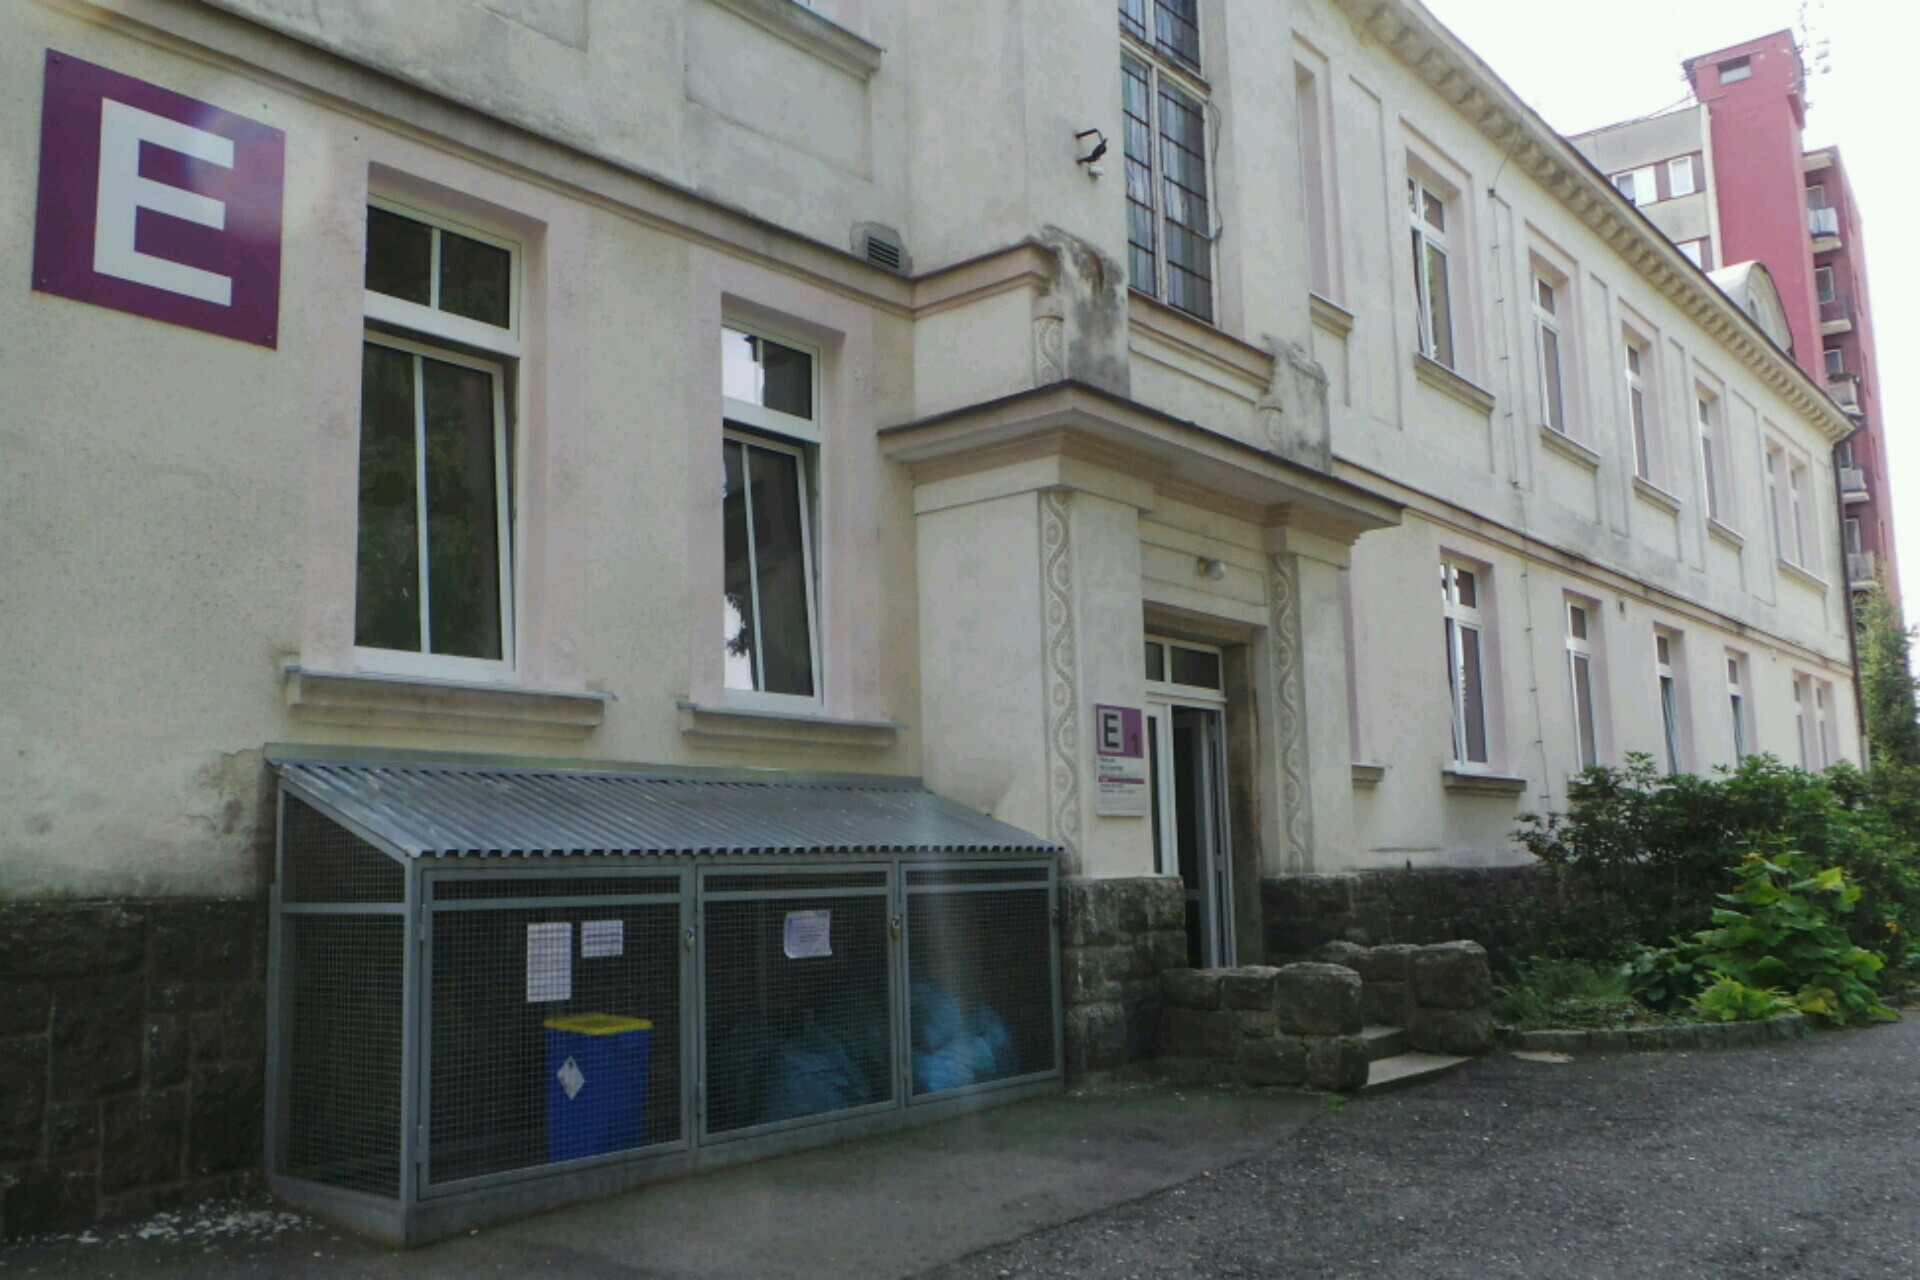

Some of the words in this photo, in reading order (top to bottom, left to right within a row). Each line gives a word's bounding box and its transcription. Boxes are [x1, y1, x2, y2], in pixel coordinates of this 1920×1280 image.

[93, 96, 235, 307] E
[1103, 712, 1119, 748] E
[1131, 733, 1138, 755] 1
